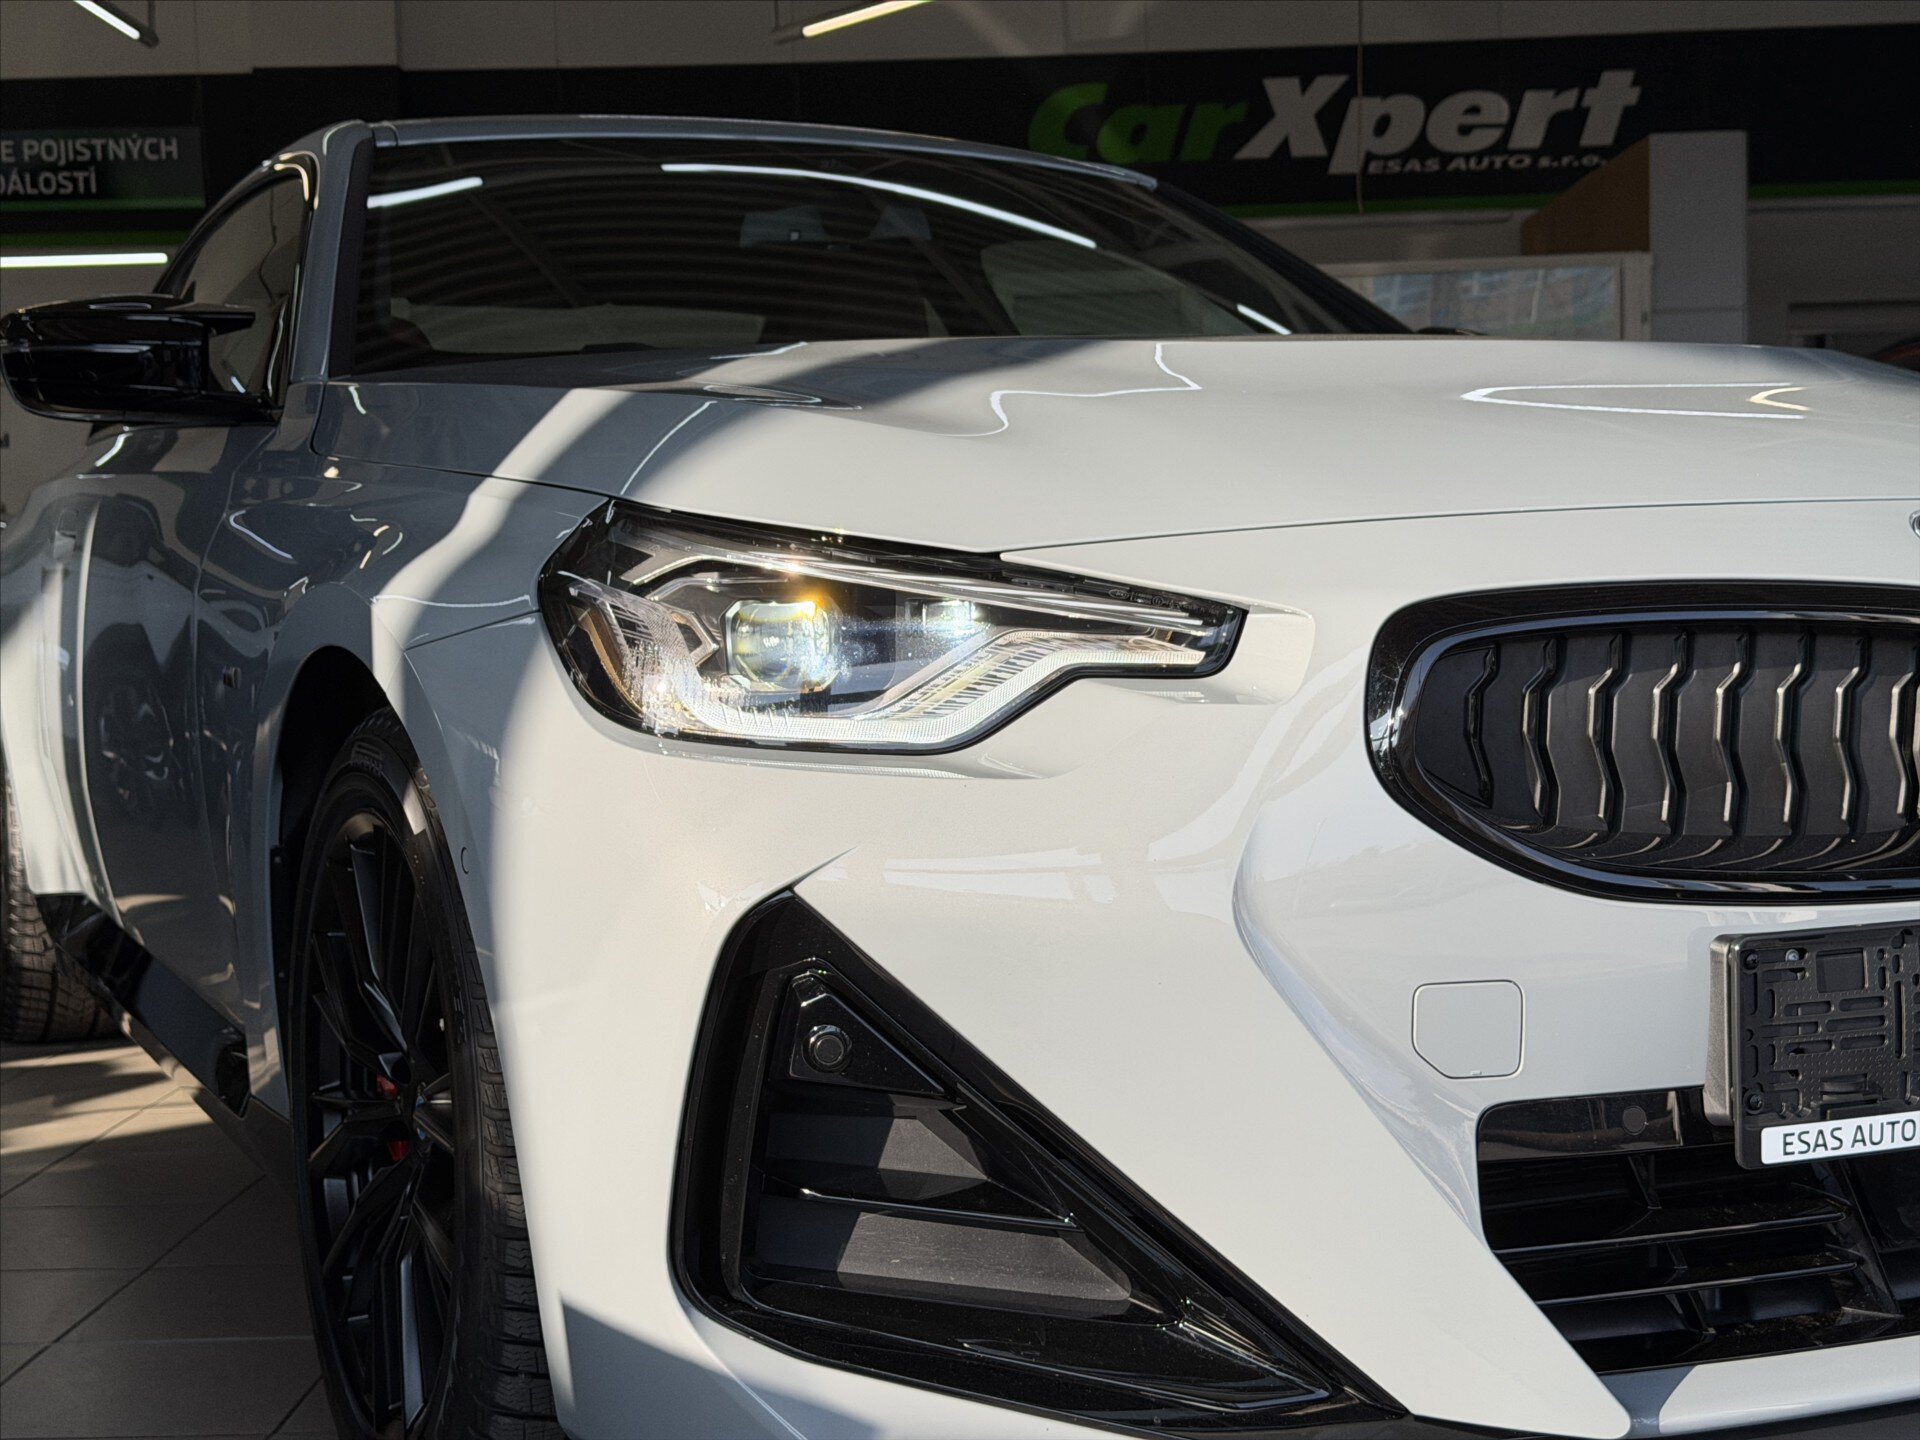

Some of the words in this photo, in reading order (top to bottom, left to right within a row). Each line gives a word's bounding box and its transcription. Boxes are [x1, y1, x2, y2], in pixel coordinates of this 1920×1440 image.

[1027, 69, 1642, 176] CarXpert
[22, 132, 179, 167] POJISTNÝCH
[1367, 157, 1441, 175] ESAS
[1446, 153, 1533, 172] AUTO
[1782, 1126, 1844, 1156] ESAS
[1850, 1118, 1917, 1149] AUTO
